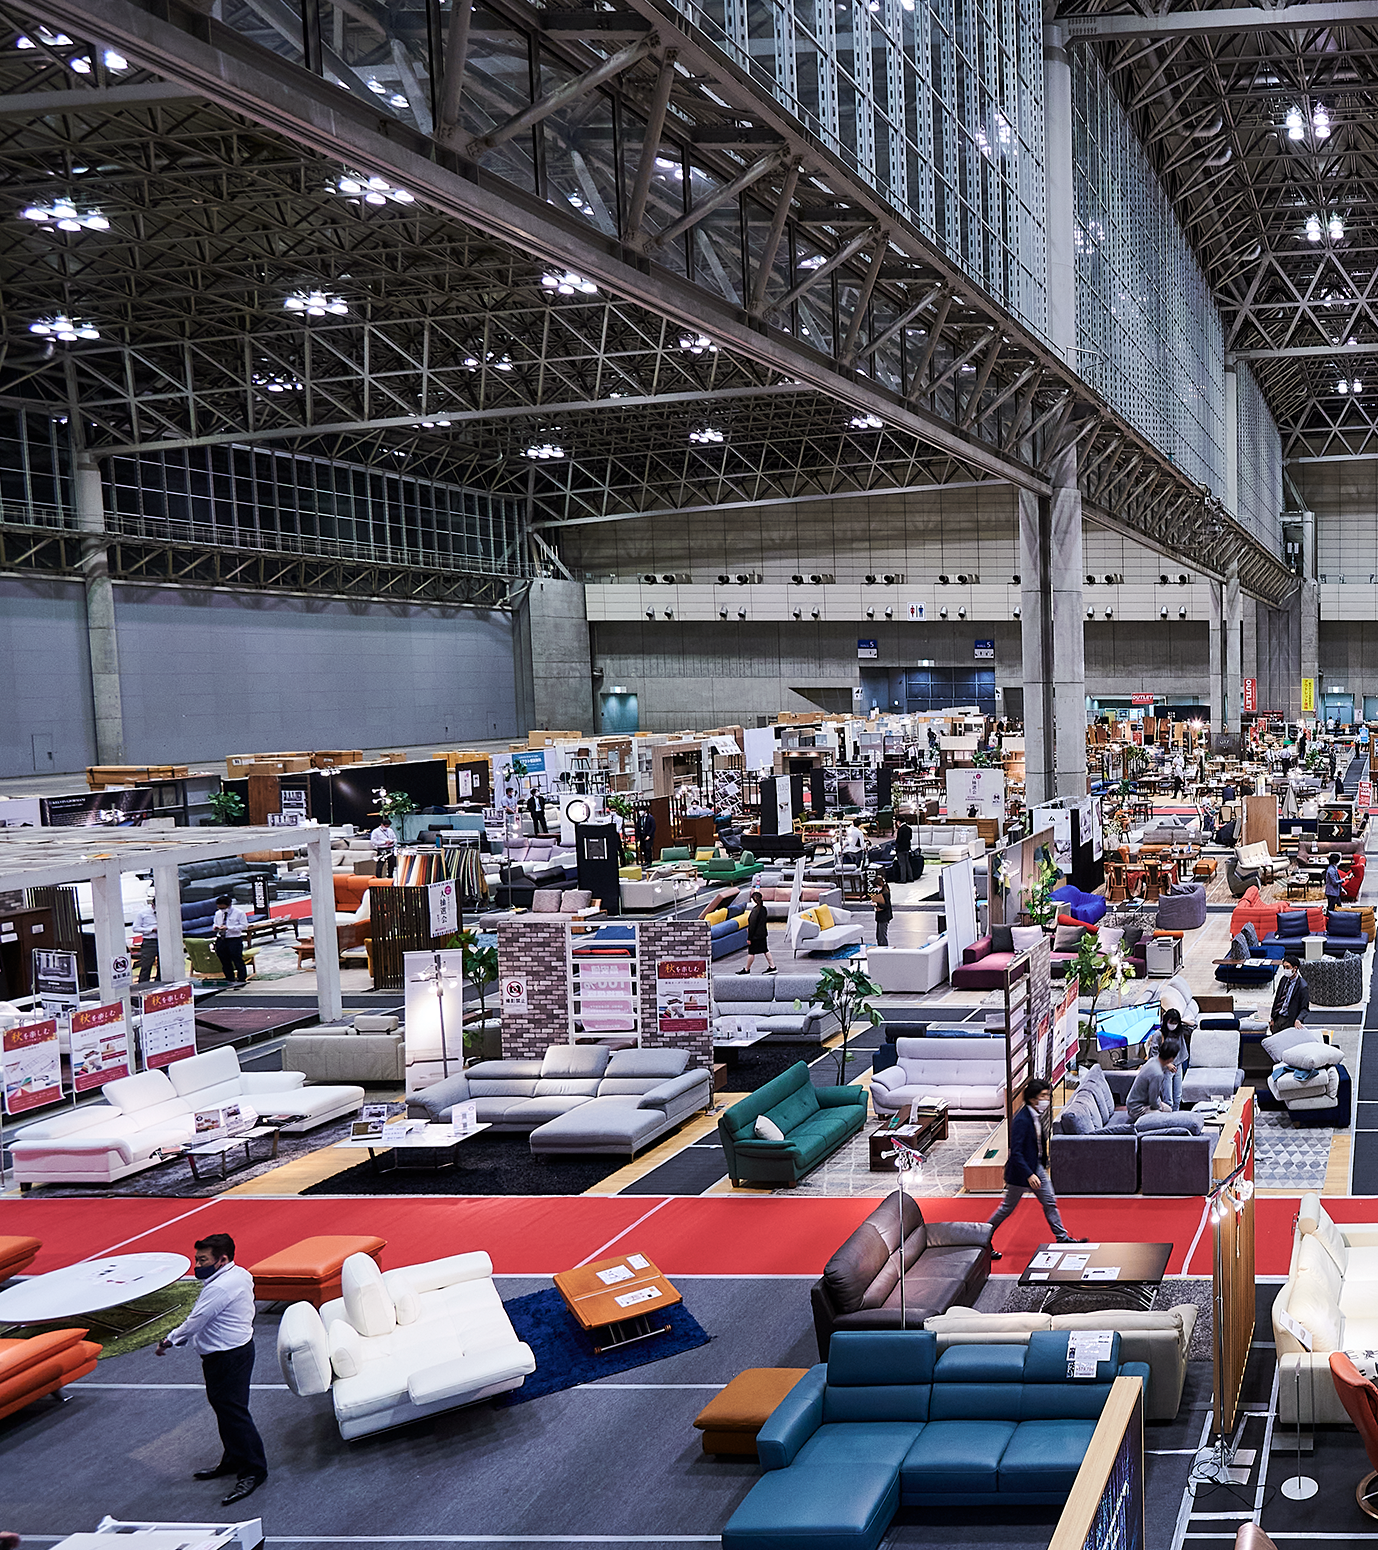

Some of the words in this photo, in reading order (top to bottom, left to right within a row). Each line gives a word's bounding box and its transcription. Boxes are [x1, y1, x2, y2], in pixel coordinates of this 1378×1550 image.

[664, 963, 700, 974] 秋を楽しむ
[151, 992, 187, 1007] 秋を楽しむ
[79, 1009, 117, 1025] 秋を楽しむ
[11, 1026, 51, 1043] 秋を楽しむ
